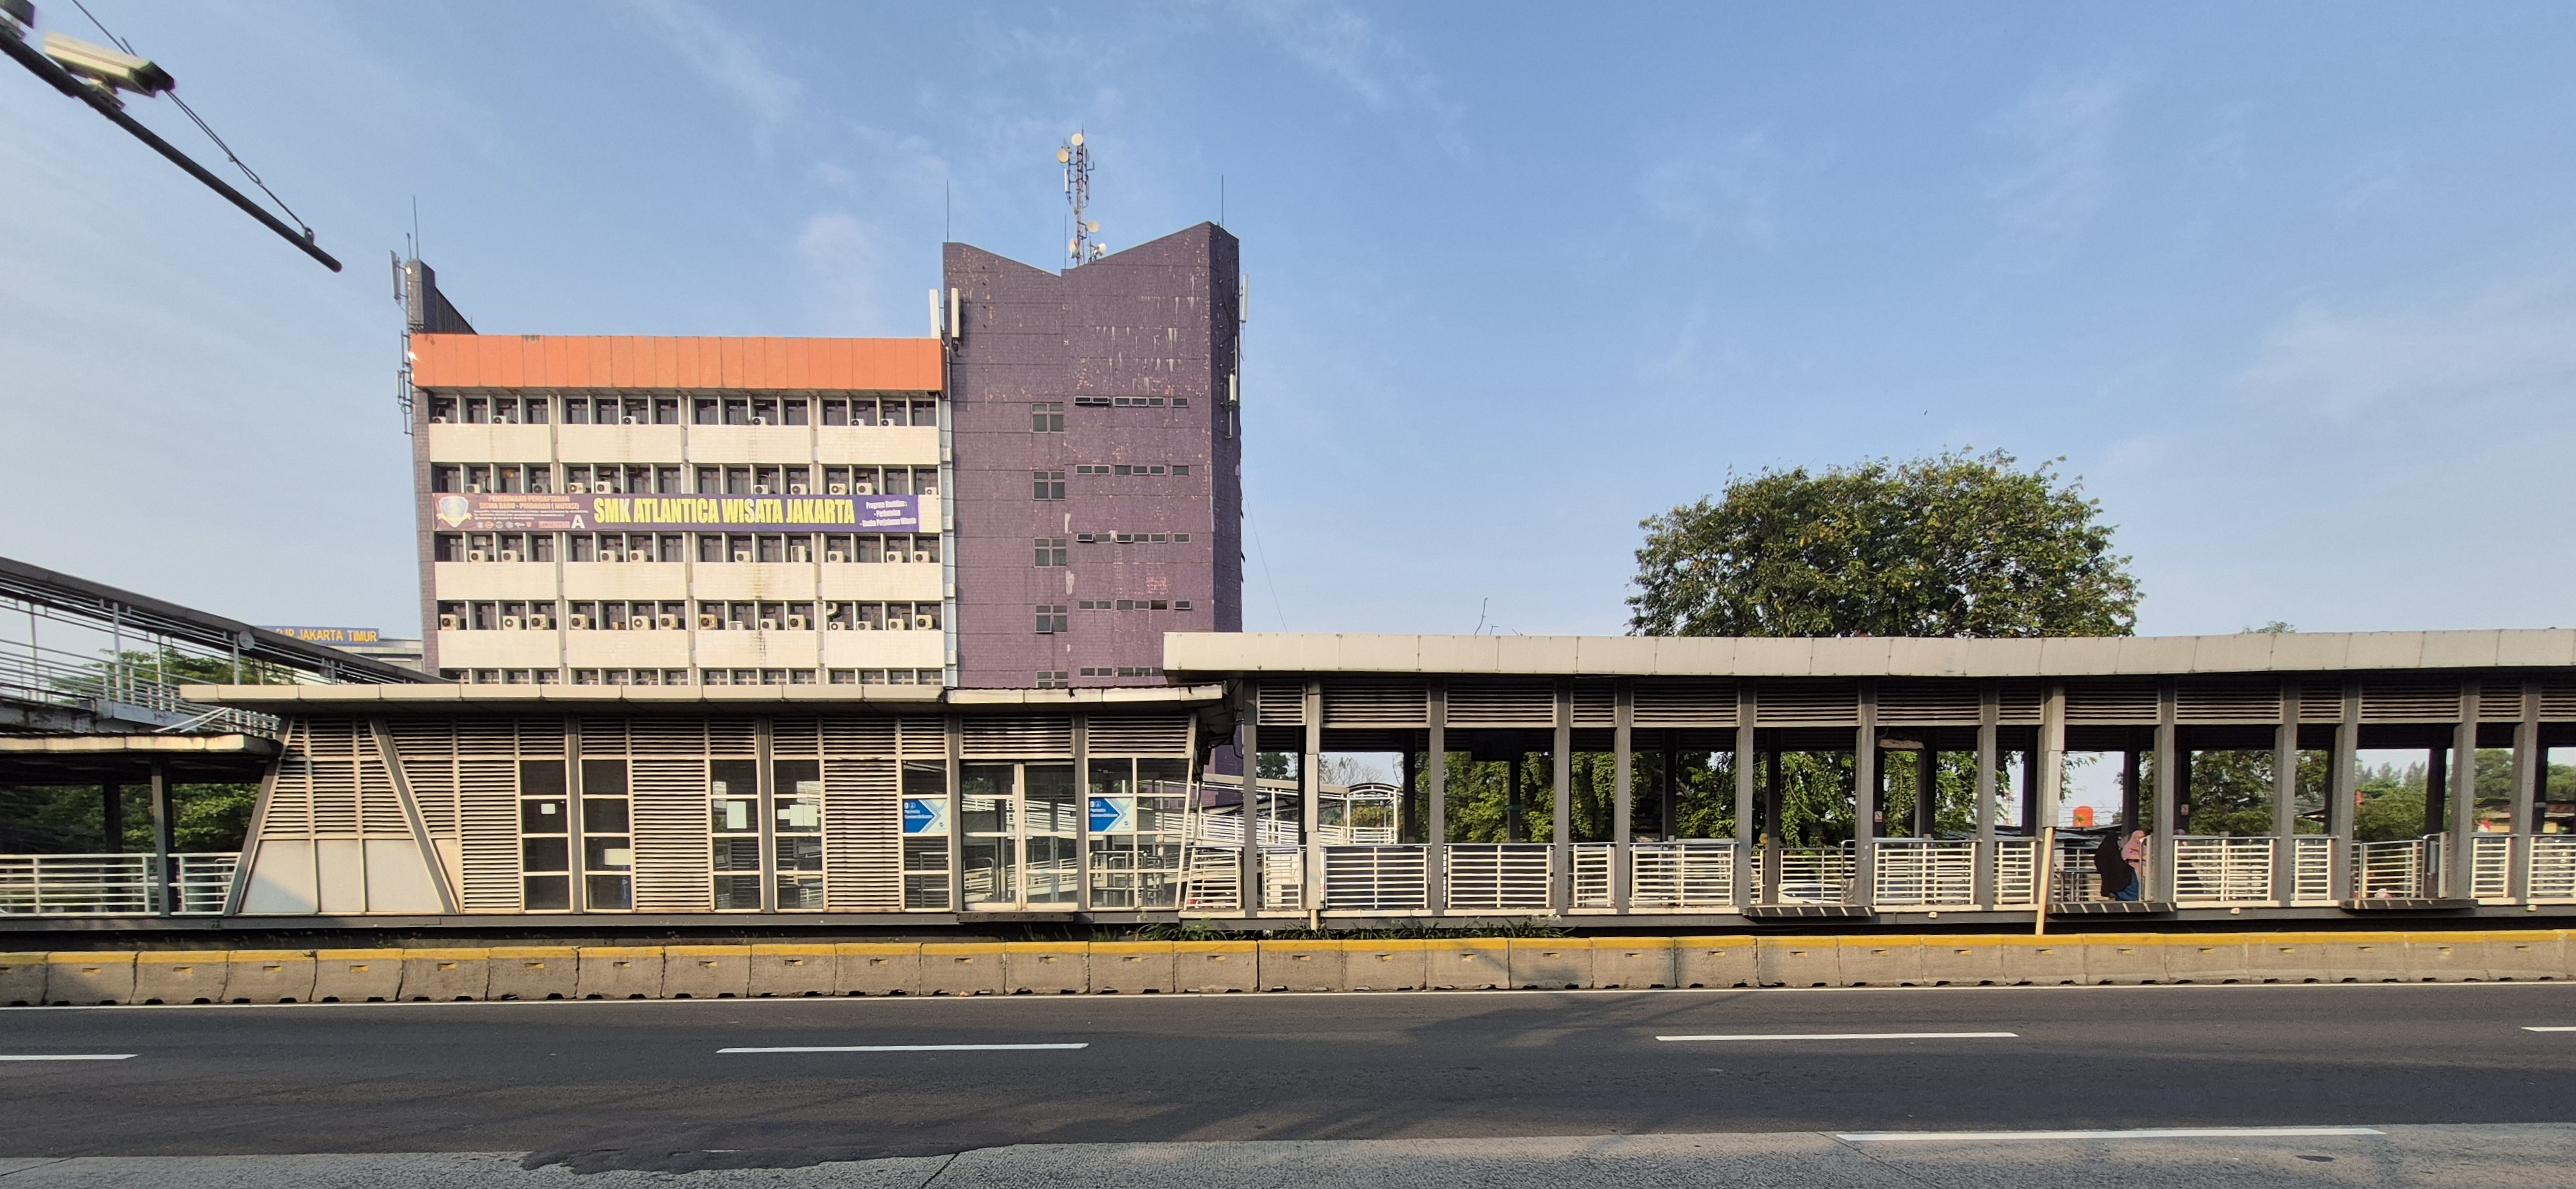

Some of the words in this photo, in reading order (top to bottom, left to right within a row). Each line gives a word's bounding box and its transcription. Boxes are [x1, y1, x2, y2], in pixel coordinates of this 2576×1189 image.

[594, 498, 632, 523] SMK
[634, 498, 719, 523] ATLANTICA
[721, 499, 784, 523] WISATA
[786, 499, 856, 524] JAKARTA
[571, 515, 586, 529] A
[298, 629, 344, 641] JAKARTA
[347, 630, 378, 642] TIMUR
